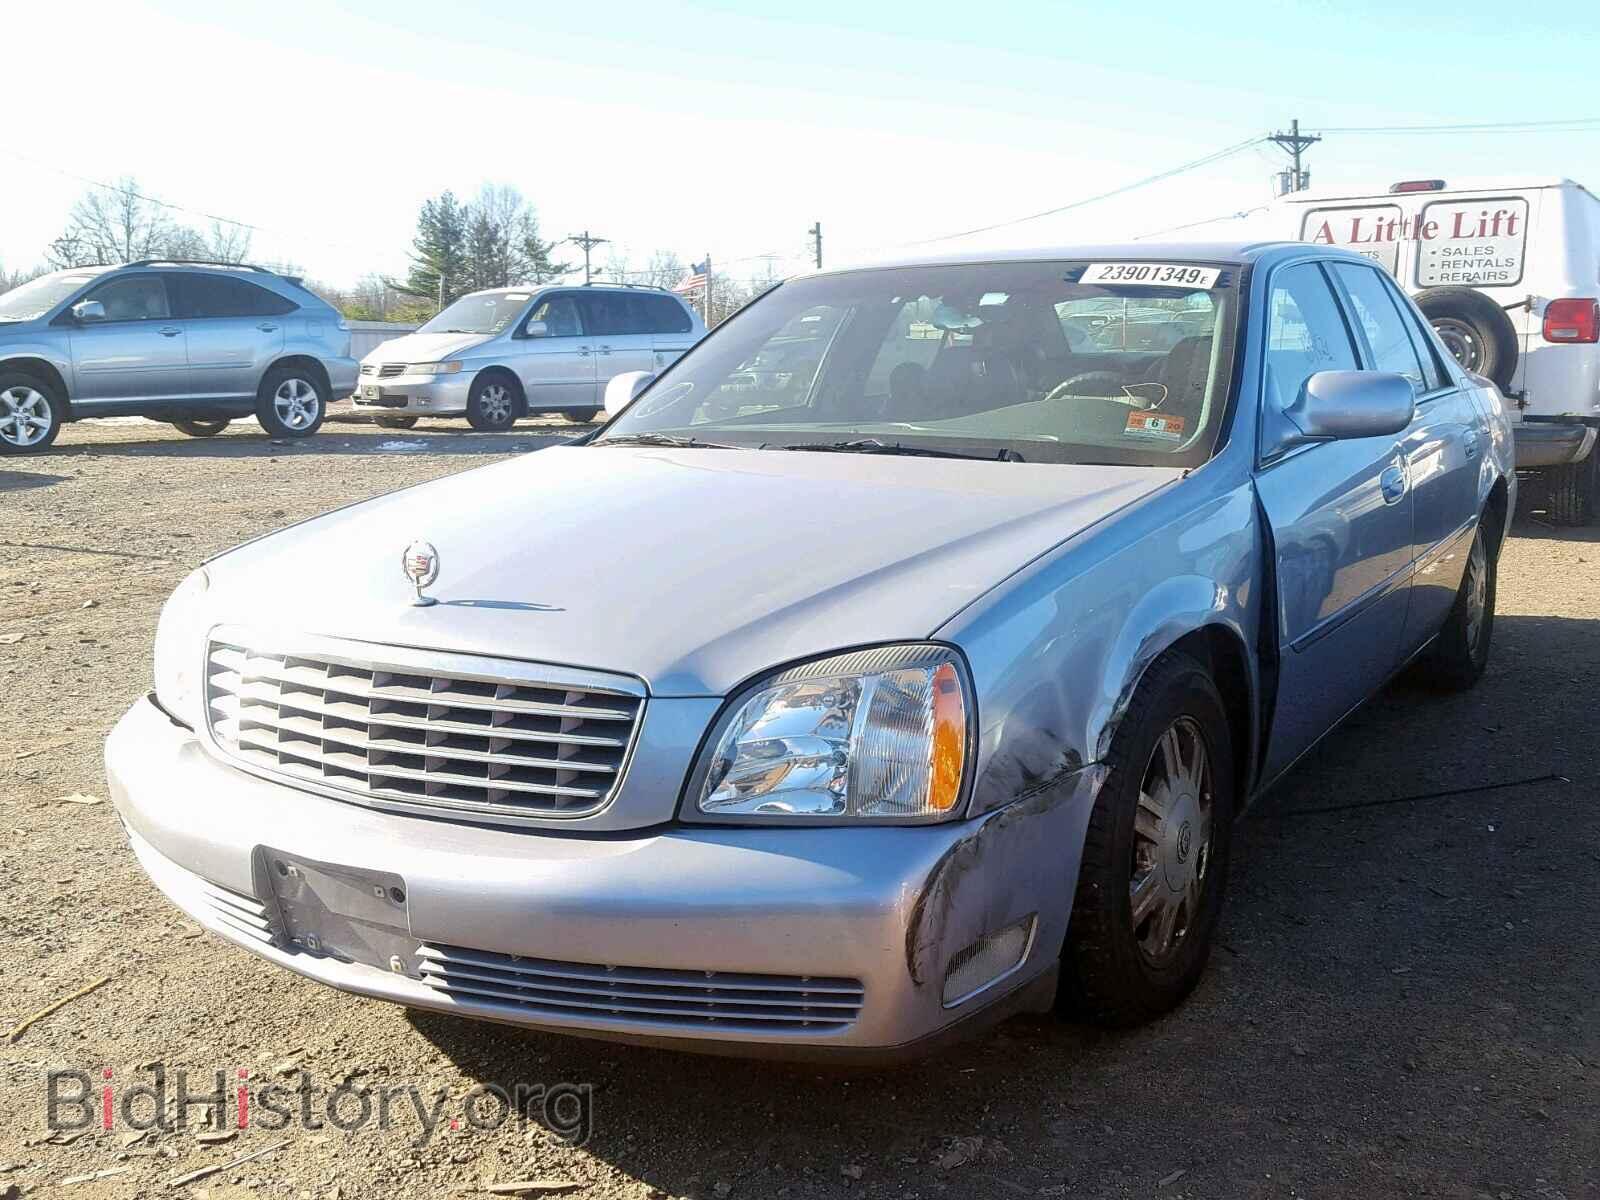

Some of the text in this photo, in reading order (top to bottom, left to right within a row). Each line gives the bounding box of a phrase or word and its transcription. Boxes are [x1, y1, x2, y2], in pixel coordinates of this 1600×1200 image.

[1312, 209, 1520, 245] A Little Lift
[1441, 246, 1495, 257] SALES
[1441, 258, 1515, 270] RENTALS
[1440, 271, 1509, 282] REPAIRS
[1151, 418, 1159, 428] 6
